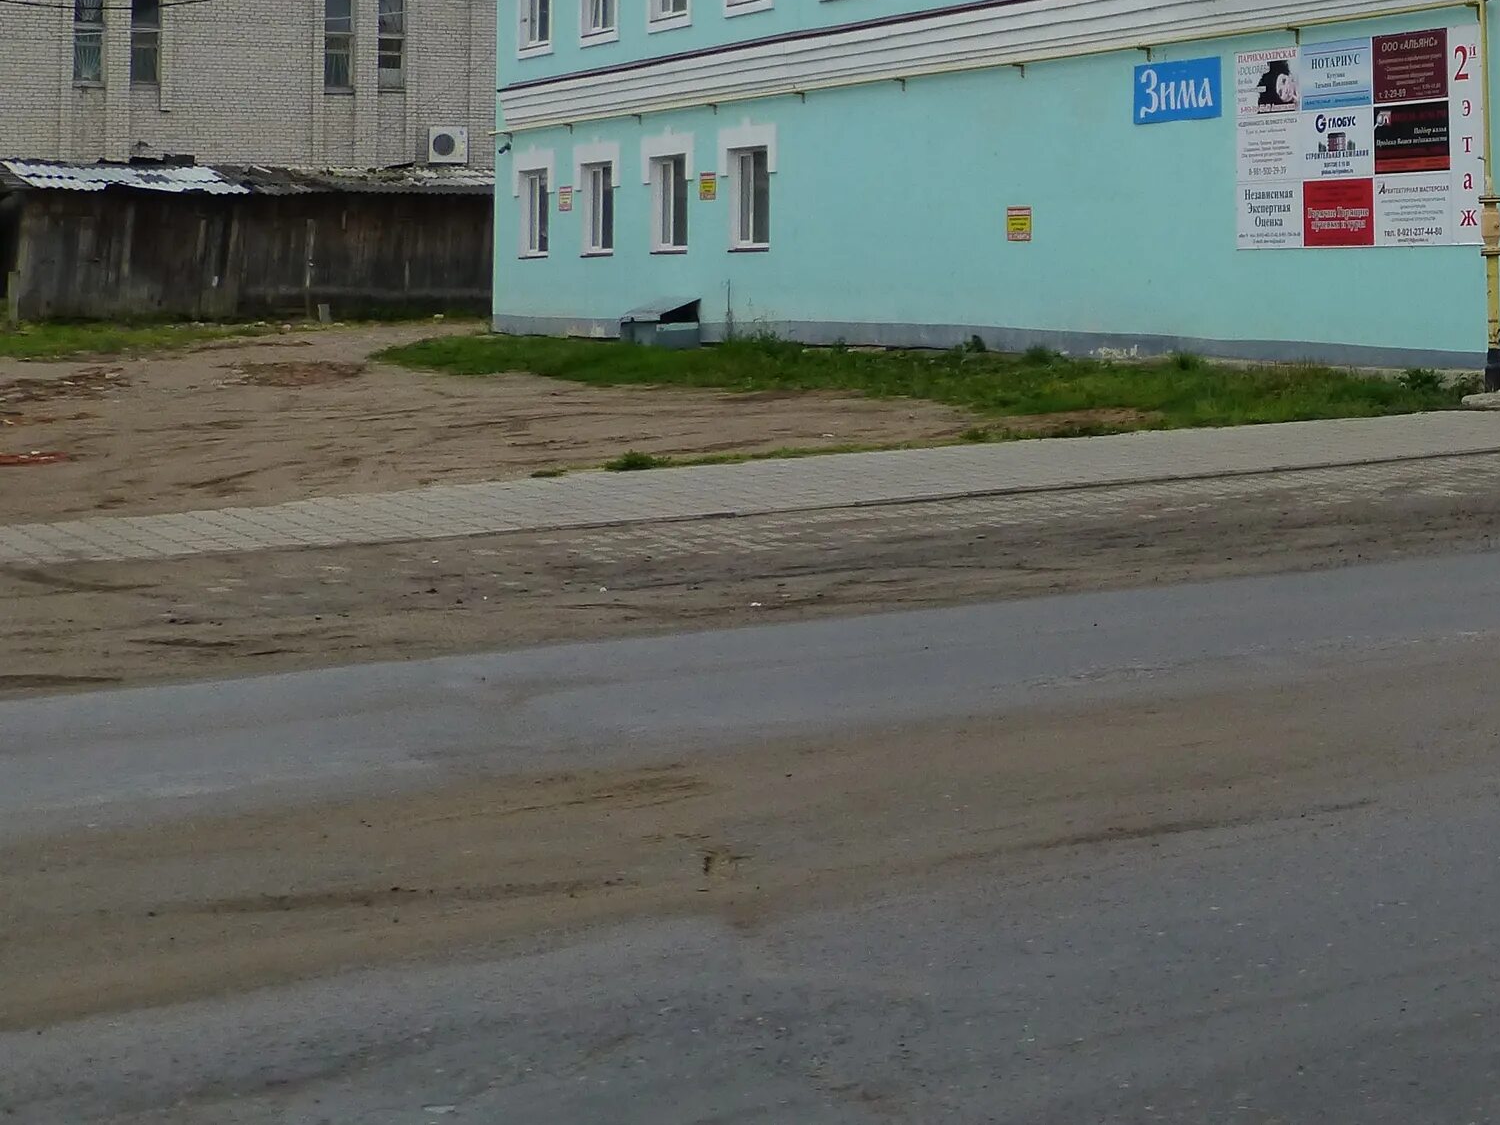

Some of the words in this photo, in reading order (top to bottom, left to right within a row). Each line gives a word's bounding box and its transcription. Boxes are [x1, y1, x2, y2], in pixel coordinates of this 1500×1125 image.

[1381, 41, 1399, 53] ООО
[1311, 53, 1361, 70] НОТАРИУС
[1140, 69, 1214, 118] Зима
[1328, 115, 1357, 129] ГЛОБУС
[1244, 188, 1294, 201] Независимая
[1247, 202, 1291, 216] Экспертная
[1254, 216, 1283, 228] Оценка
